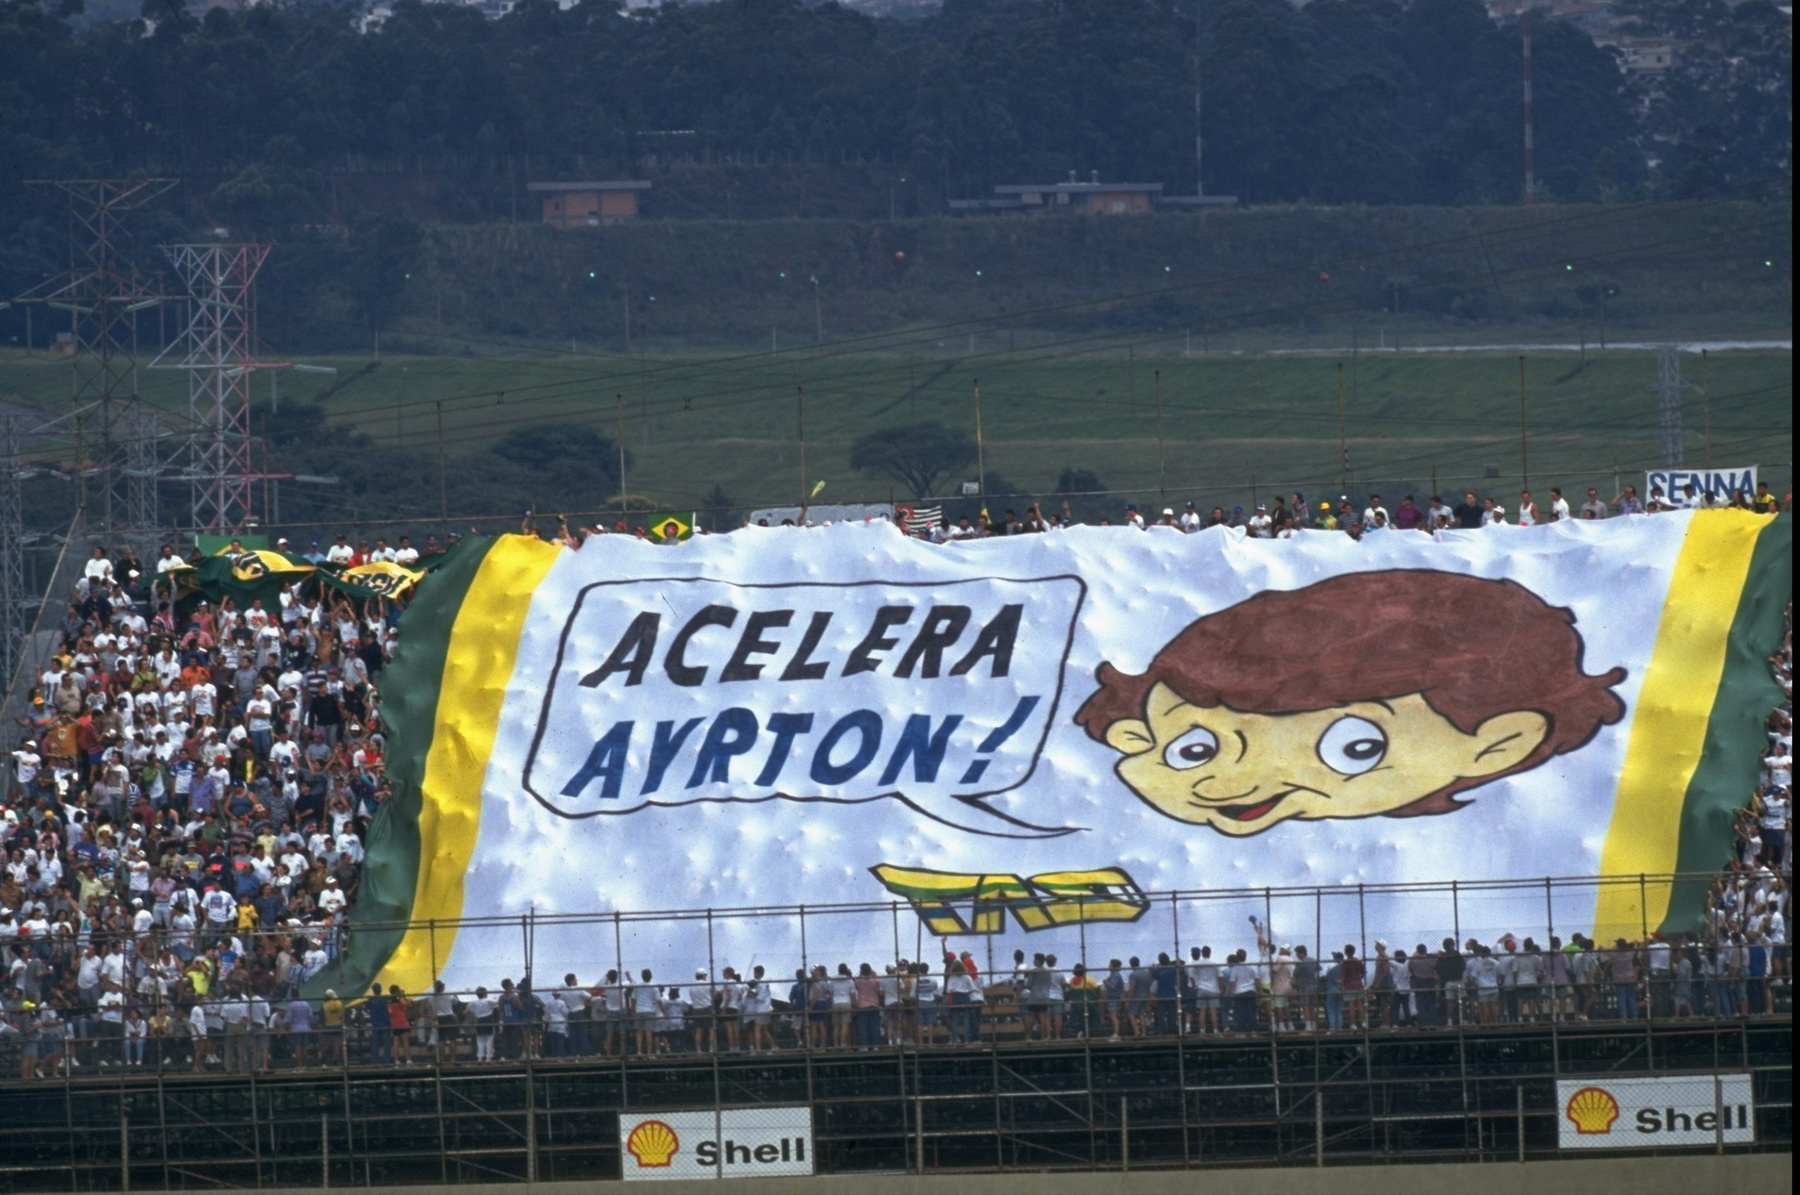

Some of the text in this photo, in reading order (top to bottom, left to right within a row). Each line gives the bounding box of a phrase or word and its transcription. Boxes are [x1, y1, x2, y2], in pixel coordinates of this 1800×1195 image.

[1649, 470, 1755, 504] SENNA
[578, 604, 1024, 687] ACELERA
[559, 695, 1041, 799] AYRTON!
[1635, 1104, 1747, 1134] Shell
[695, 1137, 805, 1166] Shell
